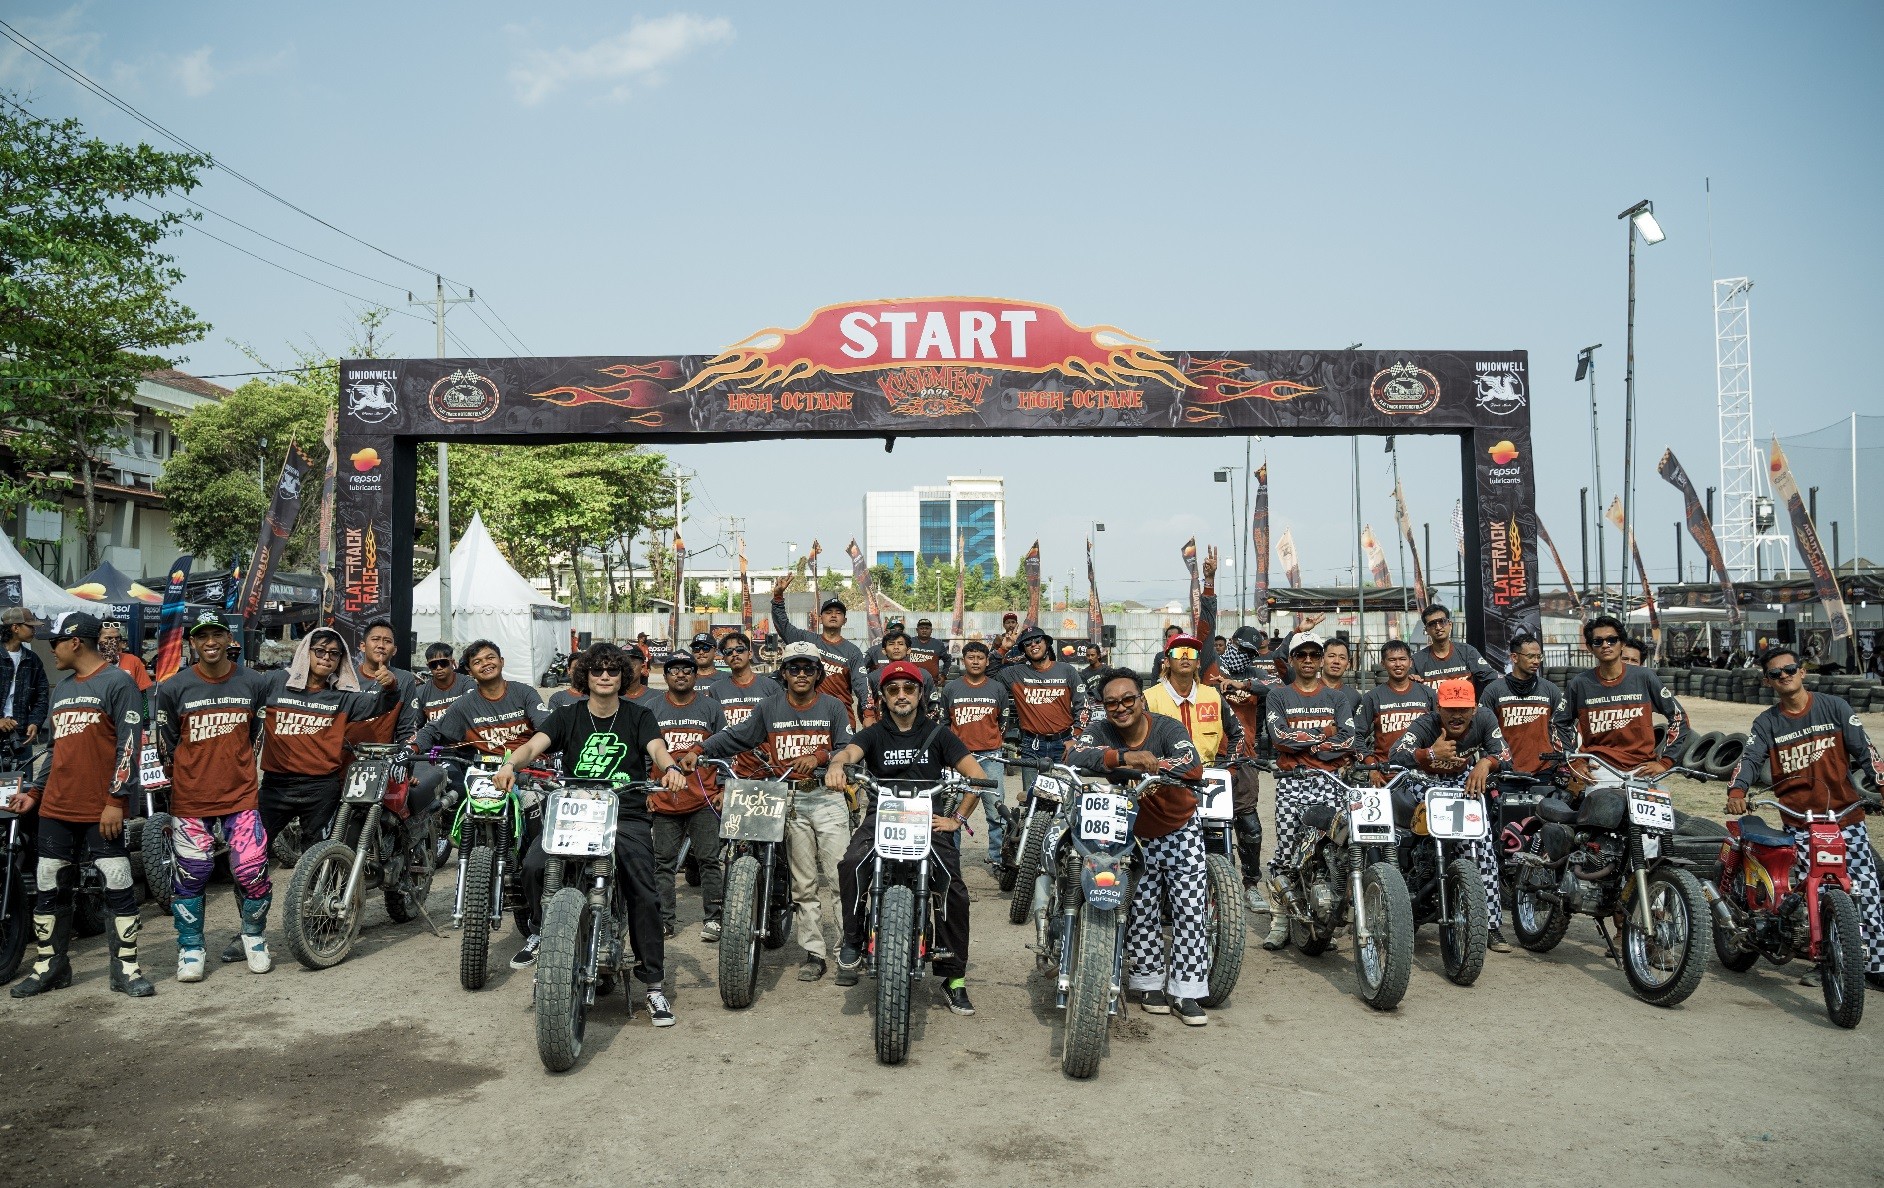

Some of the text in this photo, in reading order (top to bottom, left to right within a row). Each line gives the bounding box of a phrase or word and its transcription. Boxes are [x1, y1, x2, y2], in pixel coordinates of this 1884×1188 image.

[840, 309, 1037, 359] START
[1475, 361, 1525, 372] UNIONWELL
[349, 370, 397, 380] UNIONWELL
[876, 366, 993, 405] KUSTOMFEST
[1489, 466, 1520, 476] repsol
[350, 473, 381, 484] repsol
[1489, 477, 1521, 485] lubricants
[362, 567, 379, 604] RACE
[1508, 560, 1527, 597] RACE
[217, 697, 251, 706] KUSTOMFEST
[275, 711, 334, 727] FLATTRACK
[954, 707, 995, 718] FLATTRACK
[1502, 706, 1549, 718] FLATTRACK
[1588, 707, 1643, 721] FLATTRACK
[189, 712, 248, 729] FLATTRACK
[1504, 715, 1523, 727] RACE
[1590, 720, 1612, 735] RACE
[189, 727, 218, 743] RACE
[274, 723, 301, 735] RACE
[1382, 722, 1402, 734] RACE
[775, 734, 829, 748] FLATTRACK
[777, 746, 801, 761] RACE
[884, 749, 929, 760] CHEE
[1782, 756, 1810, 774] RACE
[143, 769, 161, 781] 040
[1038, 778, 1055, 790] 130
[731, 789, 785, 807] Fuck
[1085, 797, 1110, 811] 068
[1637, 803, 1656, 816] 072
[1446, 801, 1465, 833] 1
[884, 827, 907, 841] 019
[1084, 820, 1110, 834] 086
